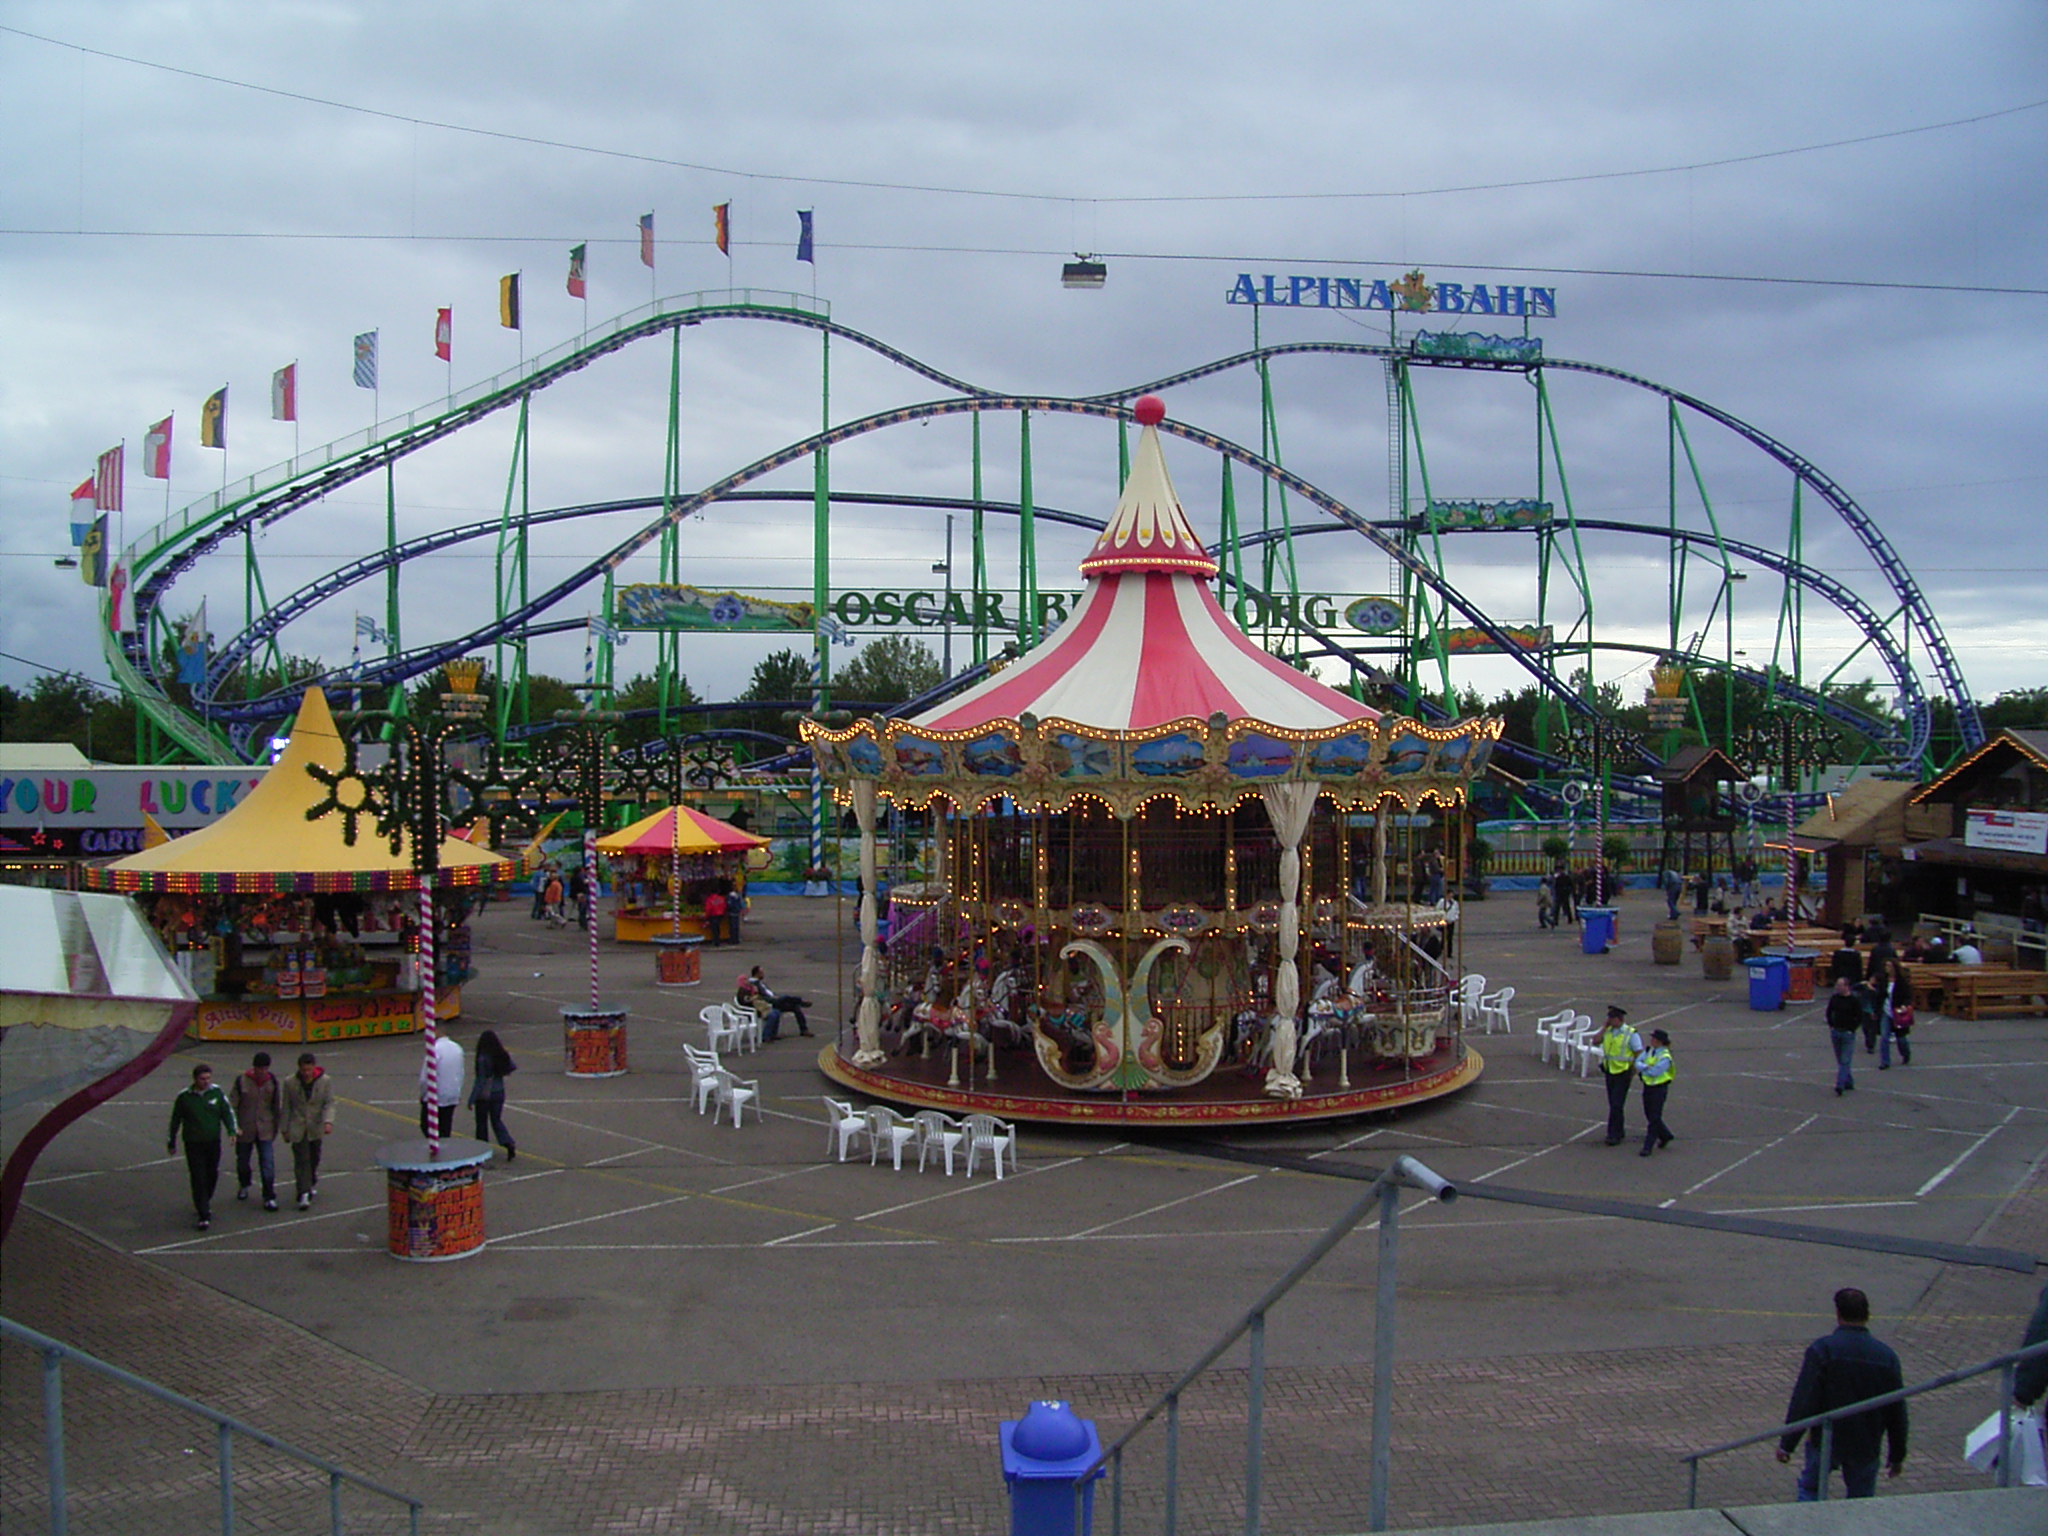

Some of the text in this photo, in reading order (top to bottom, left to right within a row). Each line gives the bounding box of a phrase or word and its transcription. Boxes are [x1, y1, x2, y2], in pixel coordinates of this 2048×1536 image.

[1229, 273, 1556, 318] ALPINA BAHN
[835, 592, 1010, 627] OSCAR
[1233, 595, 1339, 629] OHG
[139, 779, 259, 814] LUCK
[312, 1019, 410, 1038] CENTER
